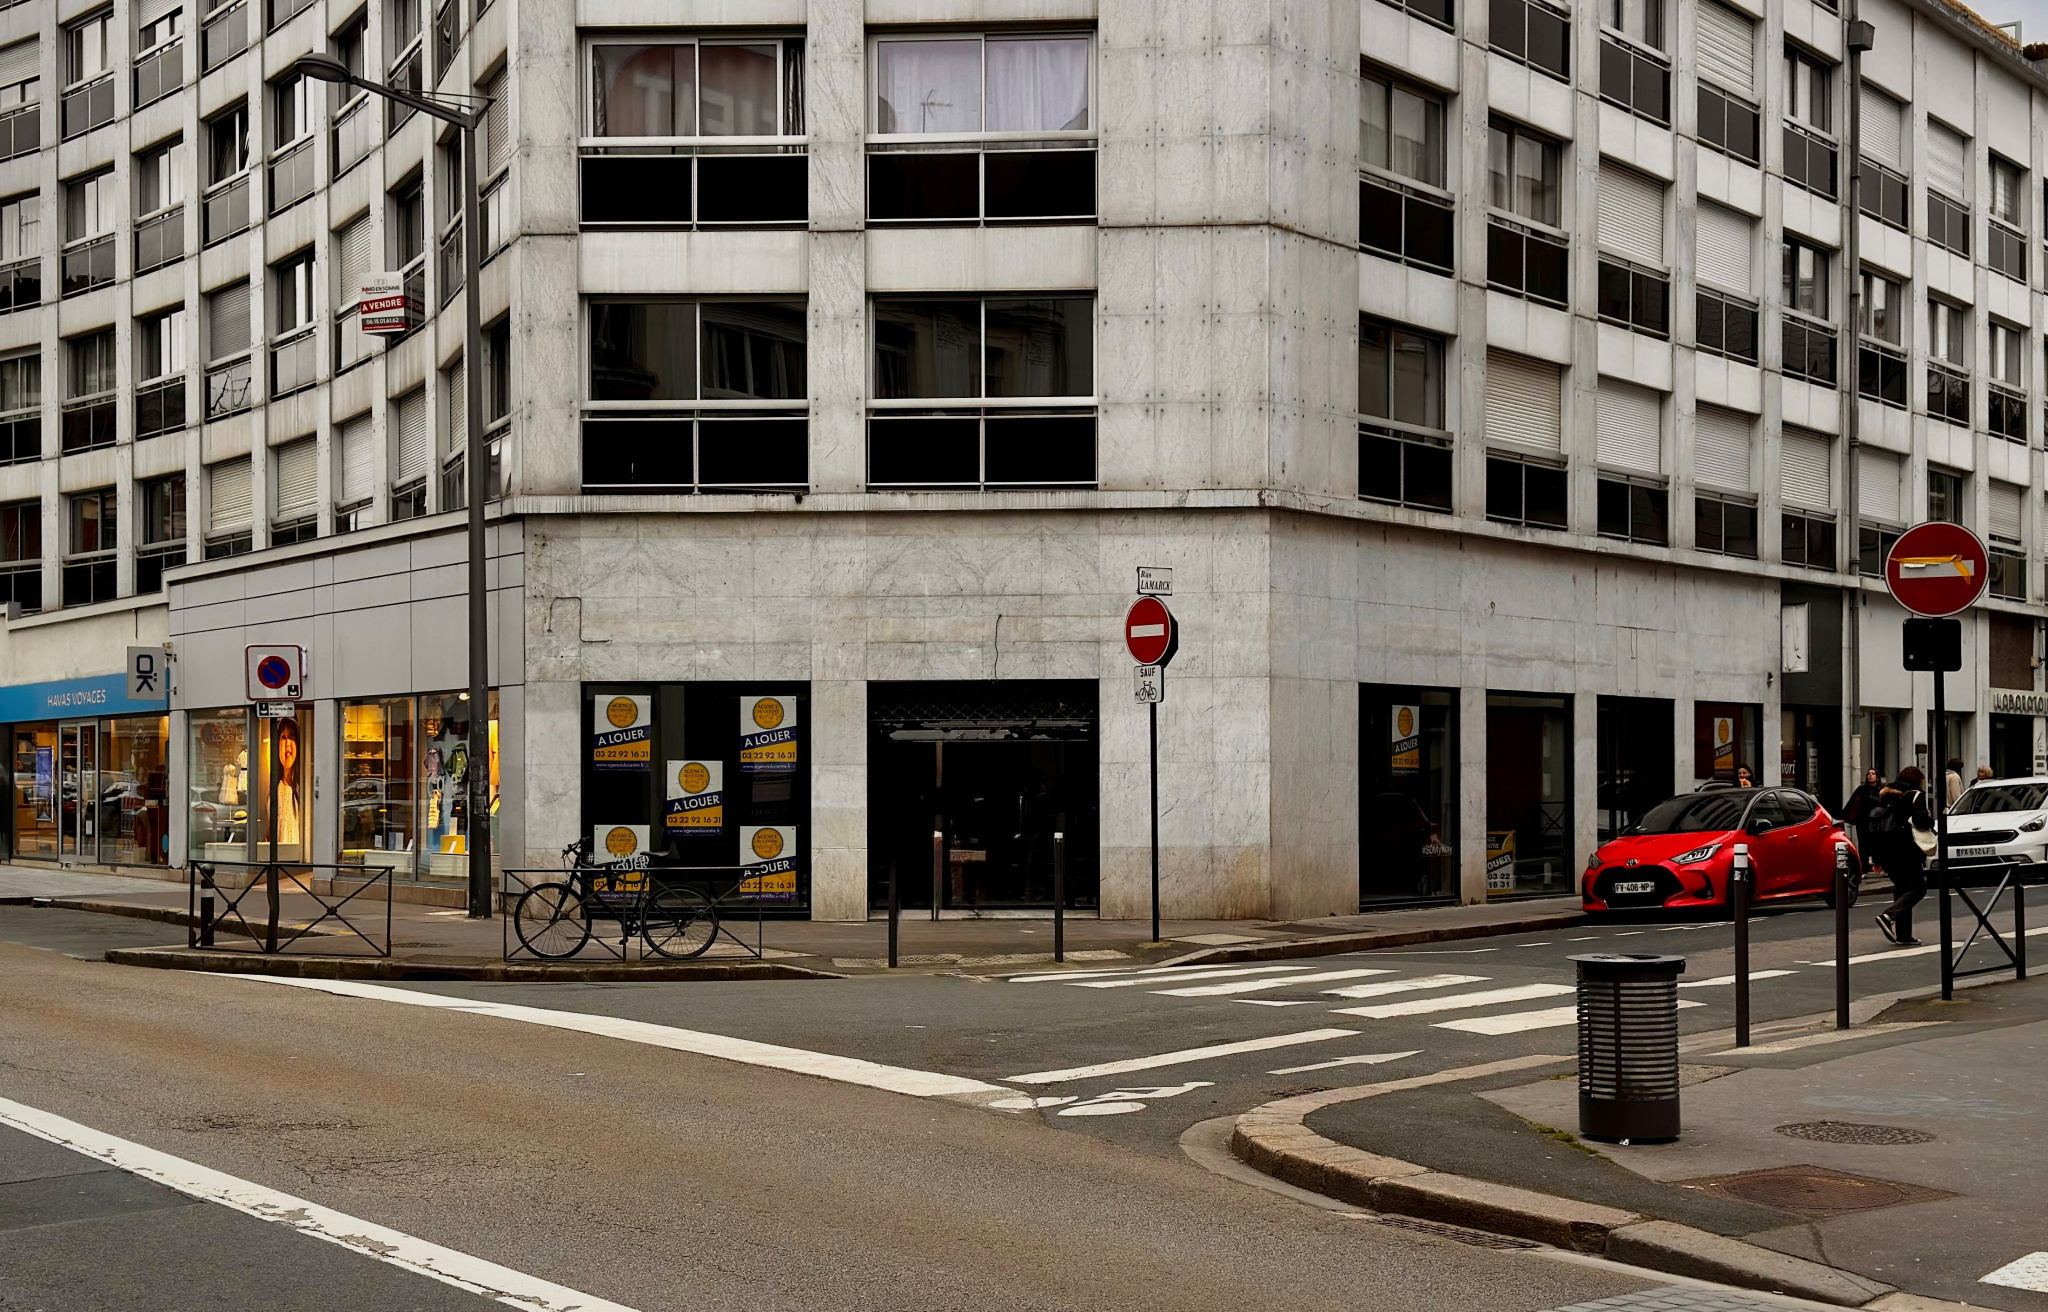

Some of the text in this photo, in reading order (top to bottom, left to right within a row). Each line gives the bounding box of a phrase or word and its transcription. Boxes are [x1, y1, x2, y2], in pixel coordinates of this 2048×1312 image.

[362, 298, 402, 312] A VENDRE
[1140, 570, 1152, 578] Rue
[1140, 580, 1171, 591] LAMARCK
[1140, 668, 1155, 678] SAUF
[47, 689, 106, 708] HAVAS VOYAGES
[1993, 692, 2048, 714] LABORATOI
[598, 729, 644, 746] A LOUER
[744, 730, 791, 748] A LOUER
[1395, 738, 1418, 753] A LOUER
[596, 750, 648, 758] 03 22 92 16 31
[673, 795, 720, 812] A LOUER
[668, 816, 721, 824] 03 22 92 16 31
[755, 861, 790, 875] OUER
[1487, 854, 1511, 870] OUER
